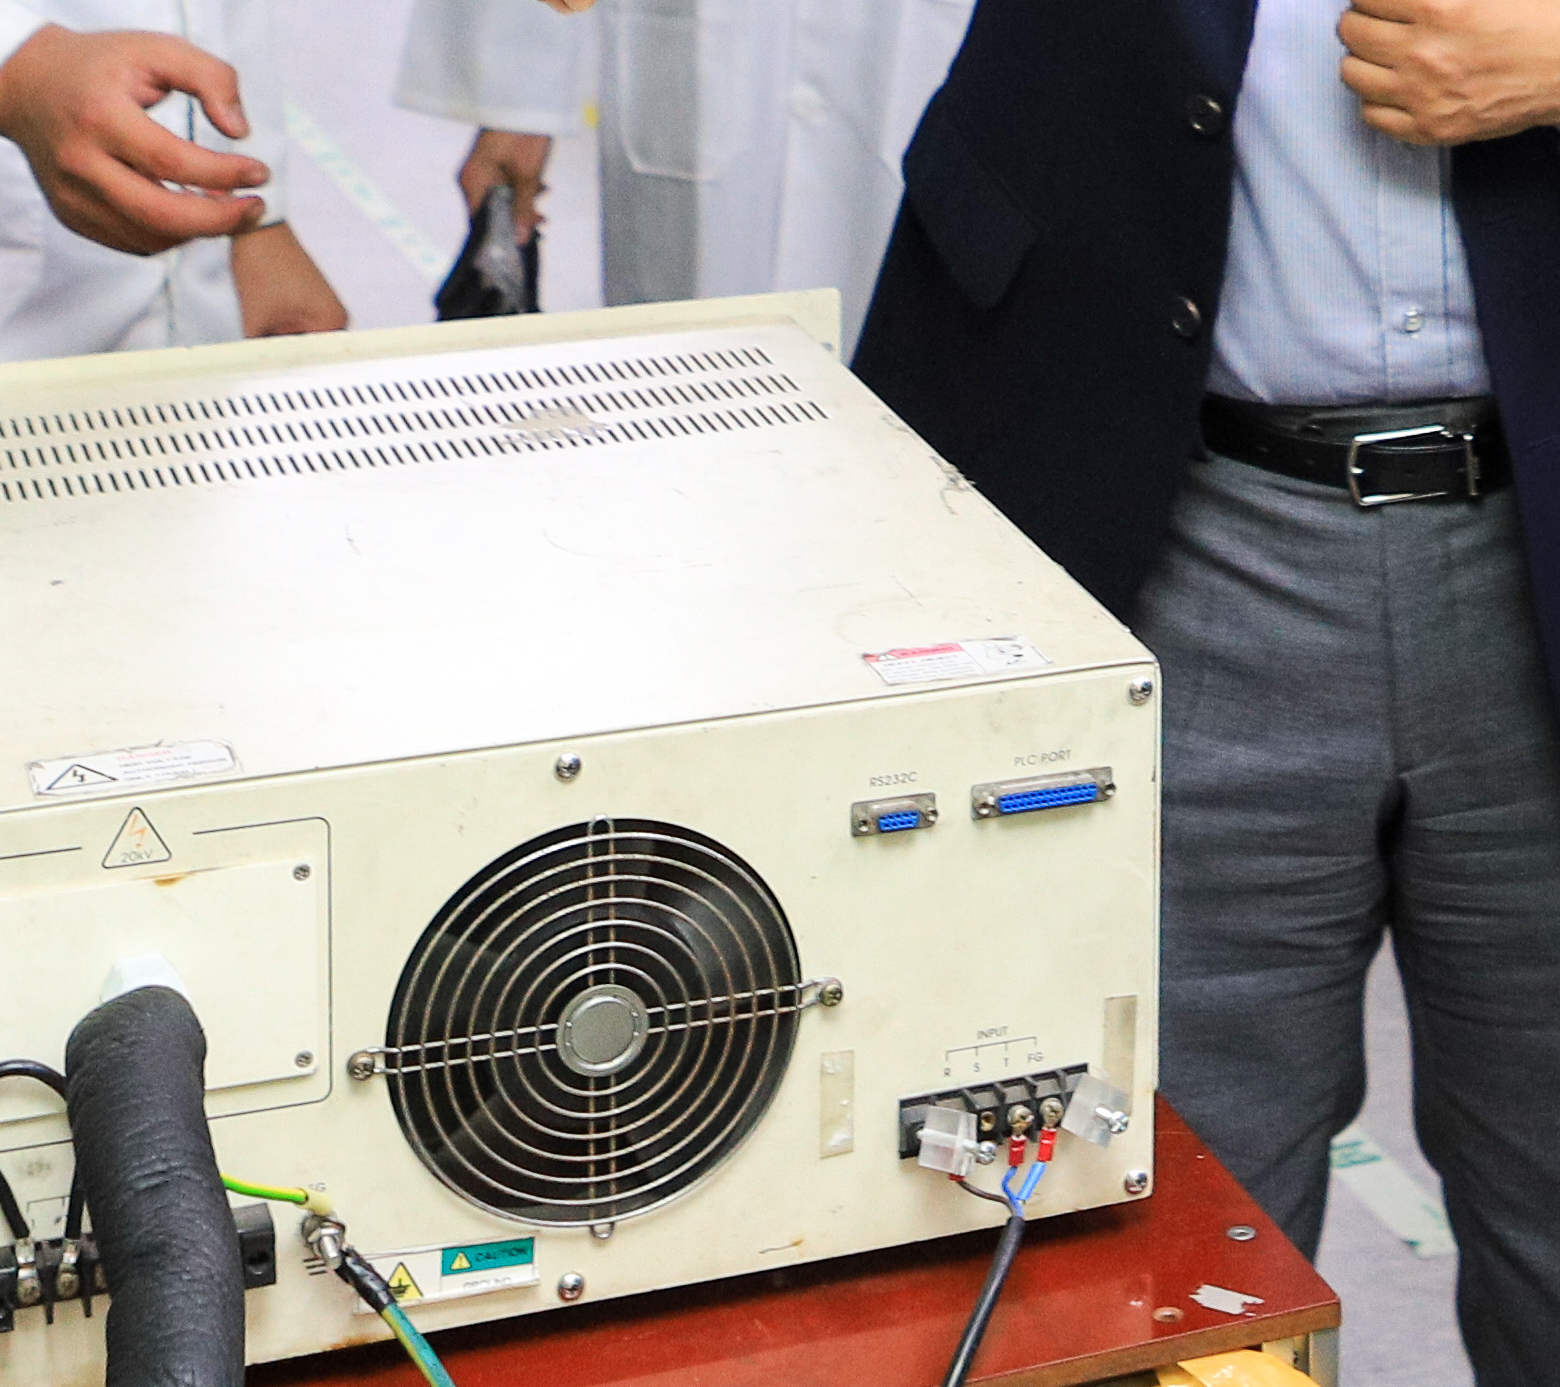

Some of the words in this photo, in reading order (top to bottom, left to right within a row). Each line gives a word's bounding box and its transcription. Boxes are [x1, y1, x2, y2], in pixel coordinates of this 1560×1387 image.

[1014, 754, 1037, 767] PLC
[1041, 749, 1072, 763] PORT
[869, 771, 919, 787] RS232C
[978, 1026, 1008, 1039] INPUT
[474, 1247, 528, 1263] CAUTION
